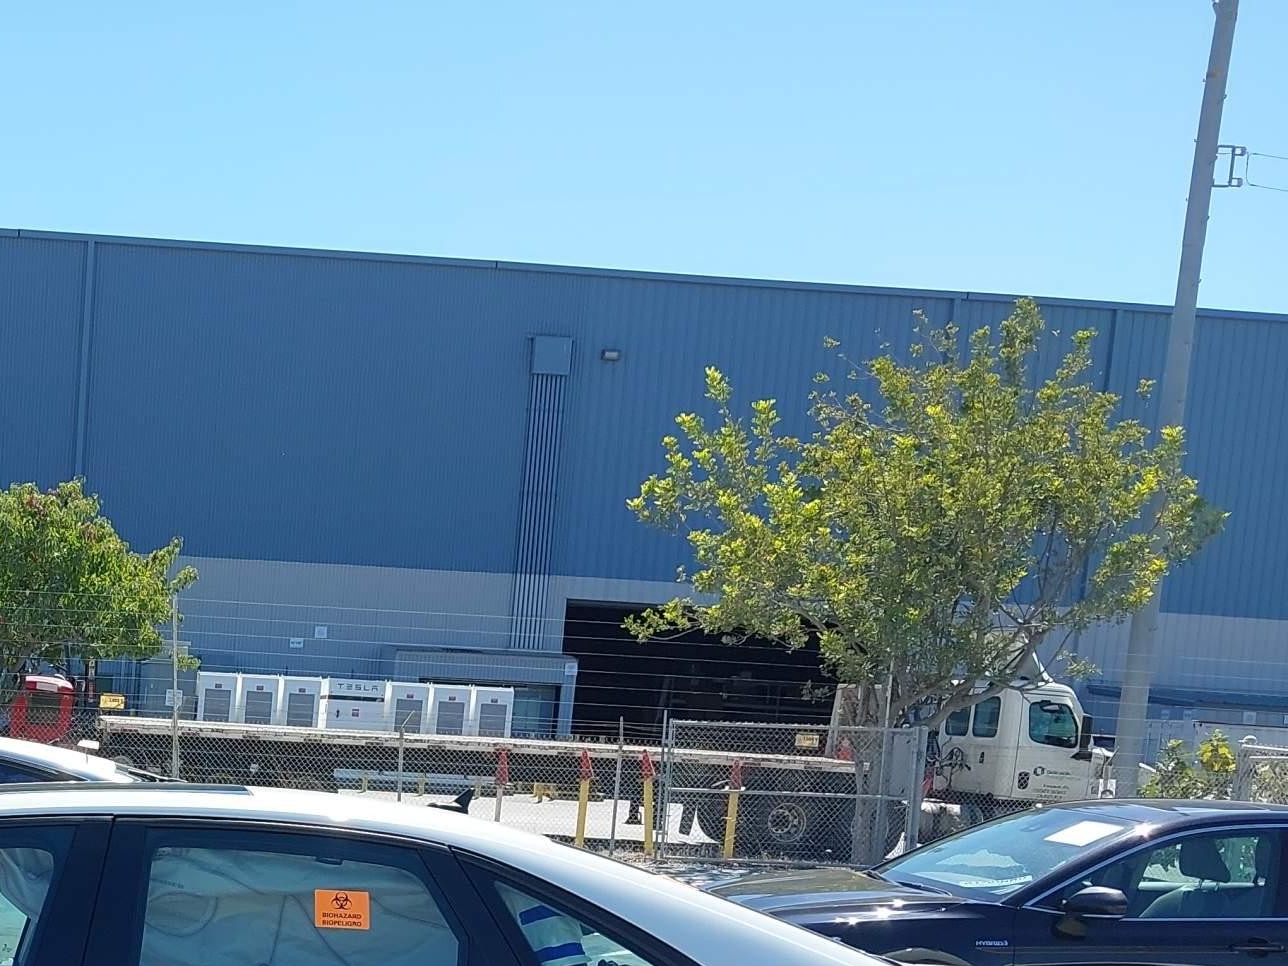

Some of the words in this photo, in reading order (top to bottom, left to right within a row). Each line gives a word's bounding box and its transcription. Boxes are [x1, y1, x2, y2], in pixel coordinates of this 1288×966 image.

[337, 682, 379, 692] TESLA
[321, 912, 362, 920] BIOHAZARD
[321, 919, 362, 927] BIOPELIGRO
